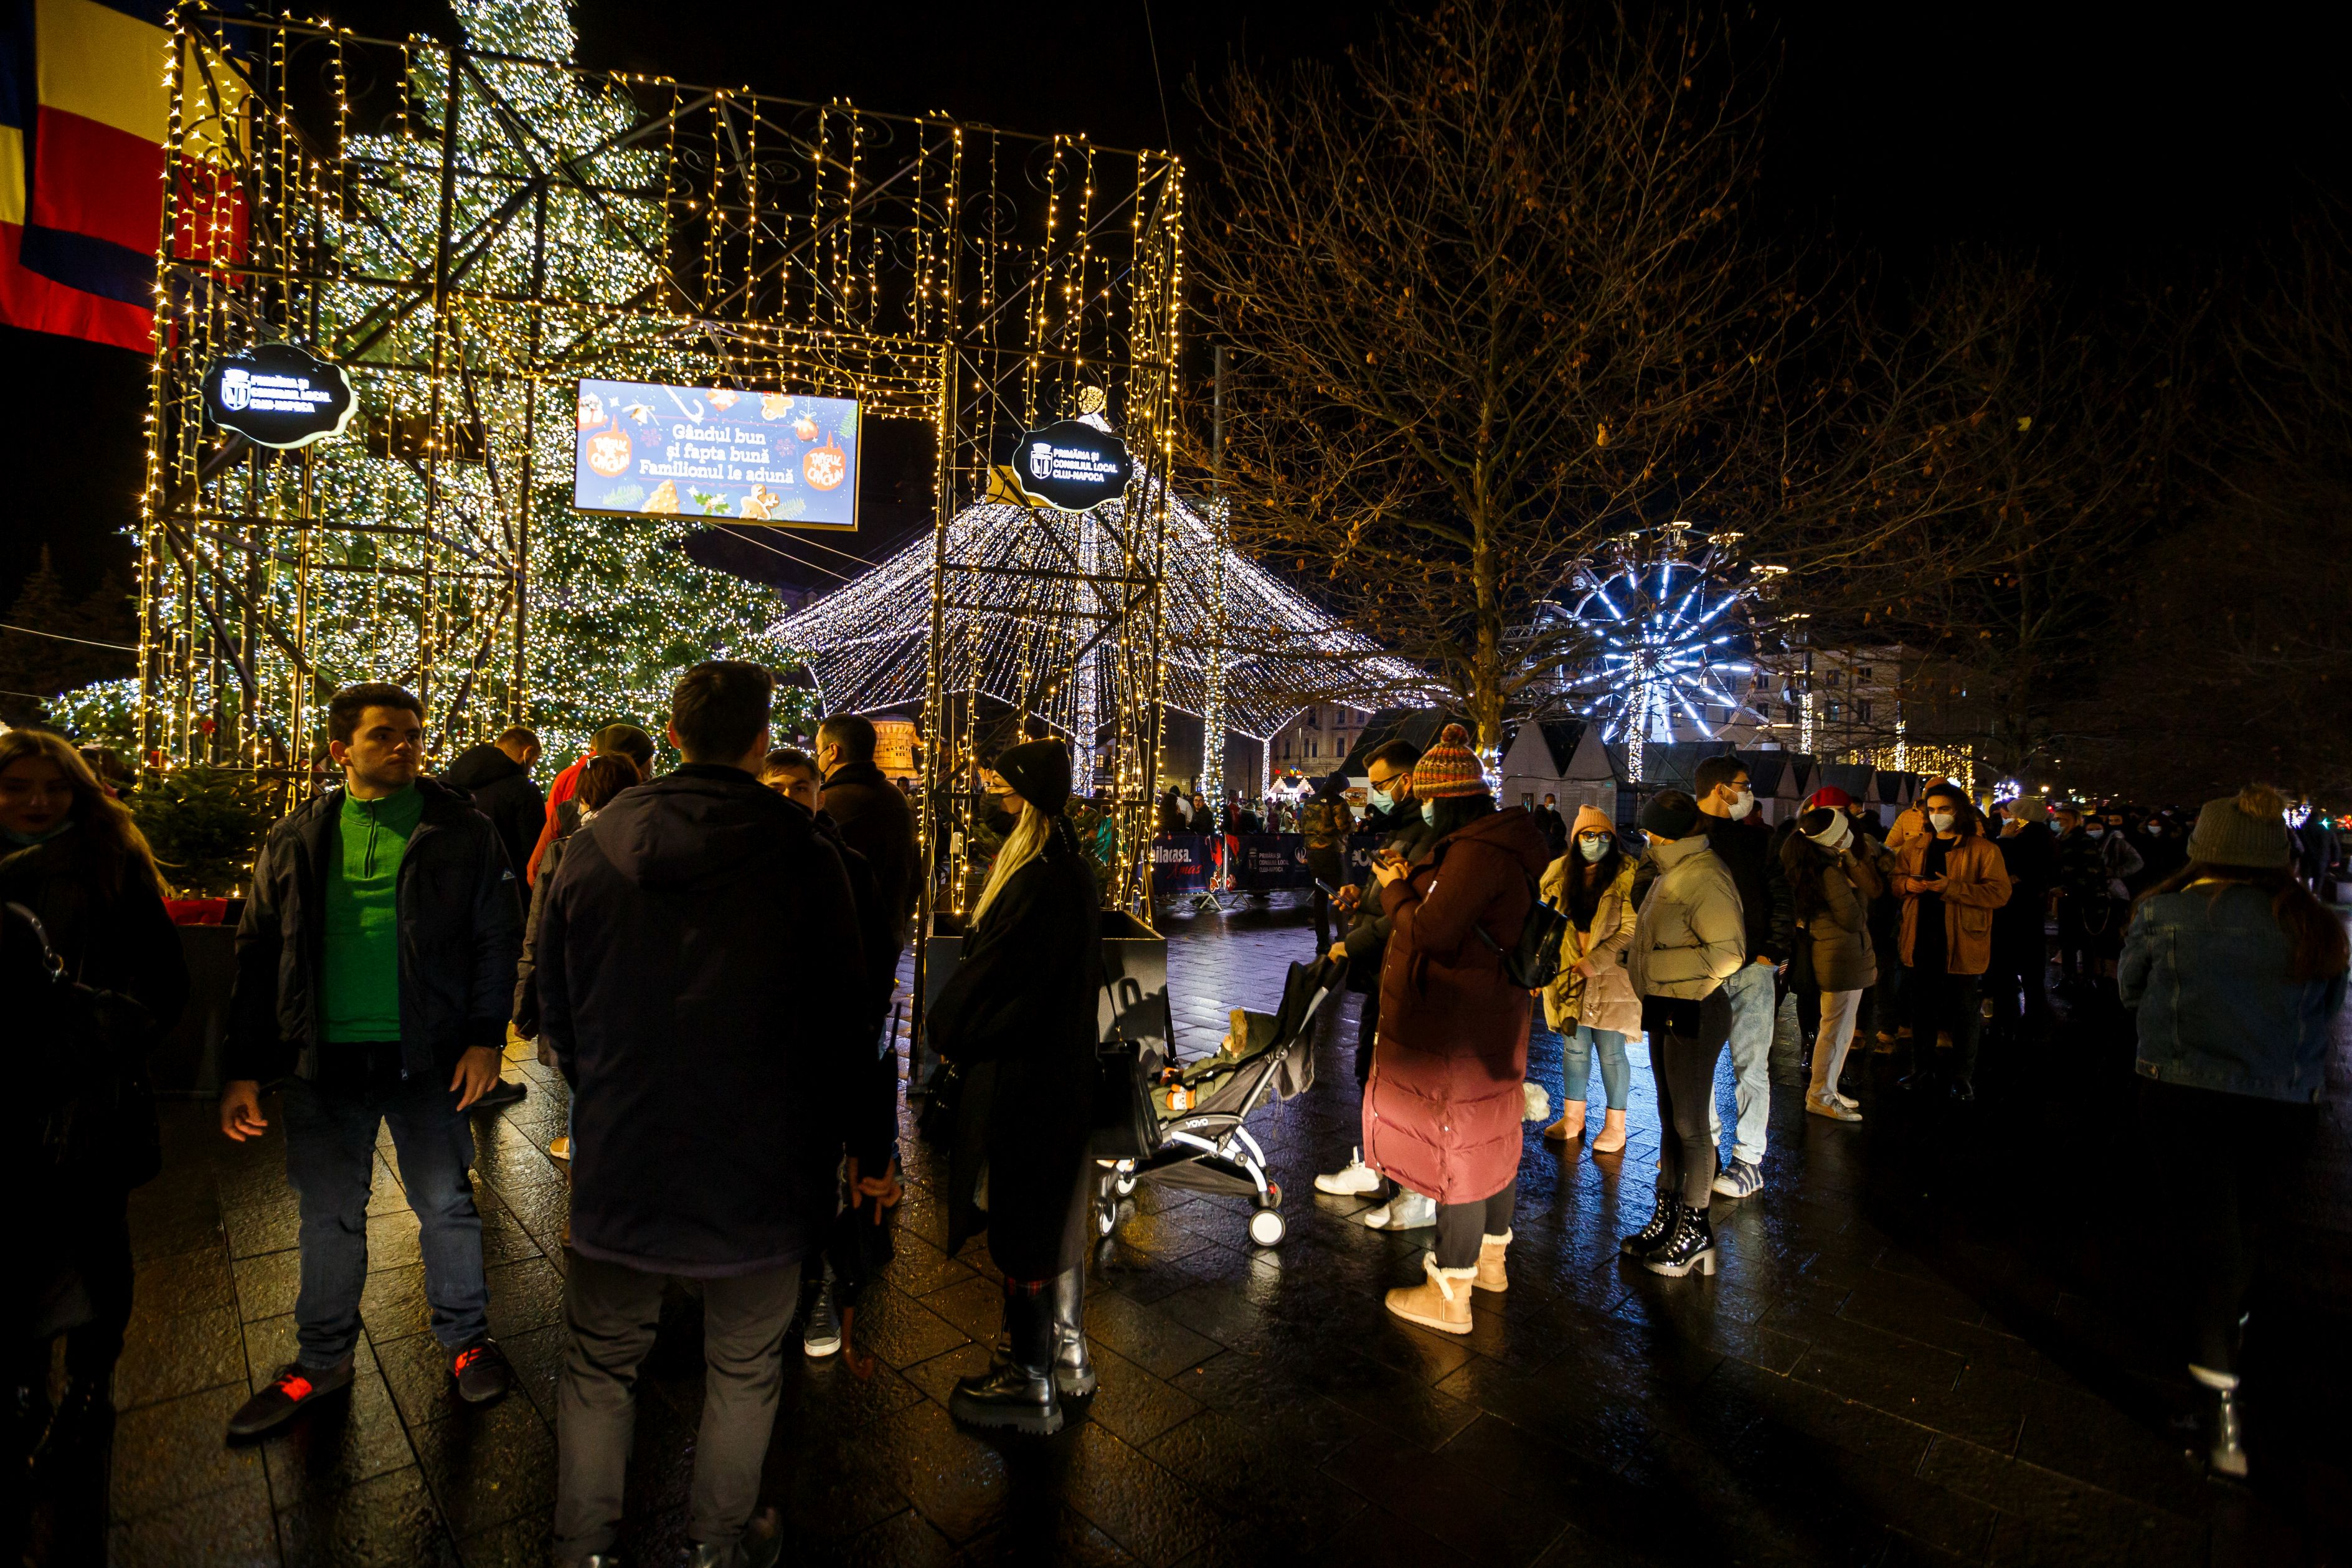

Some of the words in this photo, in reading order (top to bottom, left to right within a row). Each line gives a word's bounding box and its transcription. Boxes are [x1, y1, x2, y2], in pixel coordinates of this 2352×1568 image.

[673, 424, 731, 443] Gândul
[735, 427, 766, 445] bun
[666, 442, 680, 461] și
[684, 443, 725, 464] fapta
[730, 446, 770, 463] bună
[640, 459, 724, 479] Familionul
[728, 464, 742, 480] le
[746, 466, 794, 484] adună
[1052, 470, 1105, 482] CLUJ-NAPOCA
[1053, 459, 1093, 471] CONSILIUL
[1093, 463, 1118, 473] LOCAL
[1166, 856, 1203, 880] Xmas
[1185, 1118, 1209, 1129] YOYO
